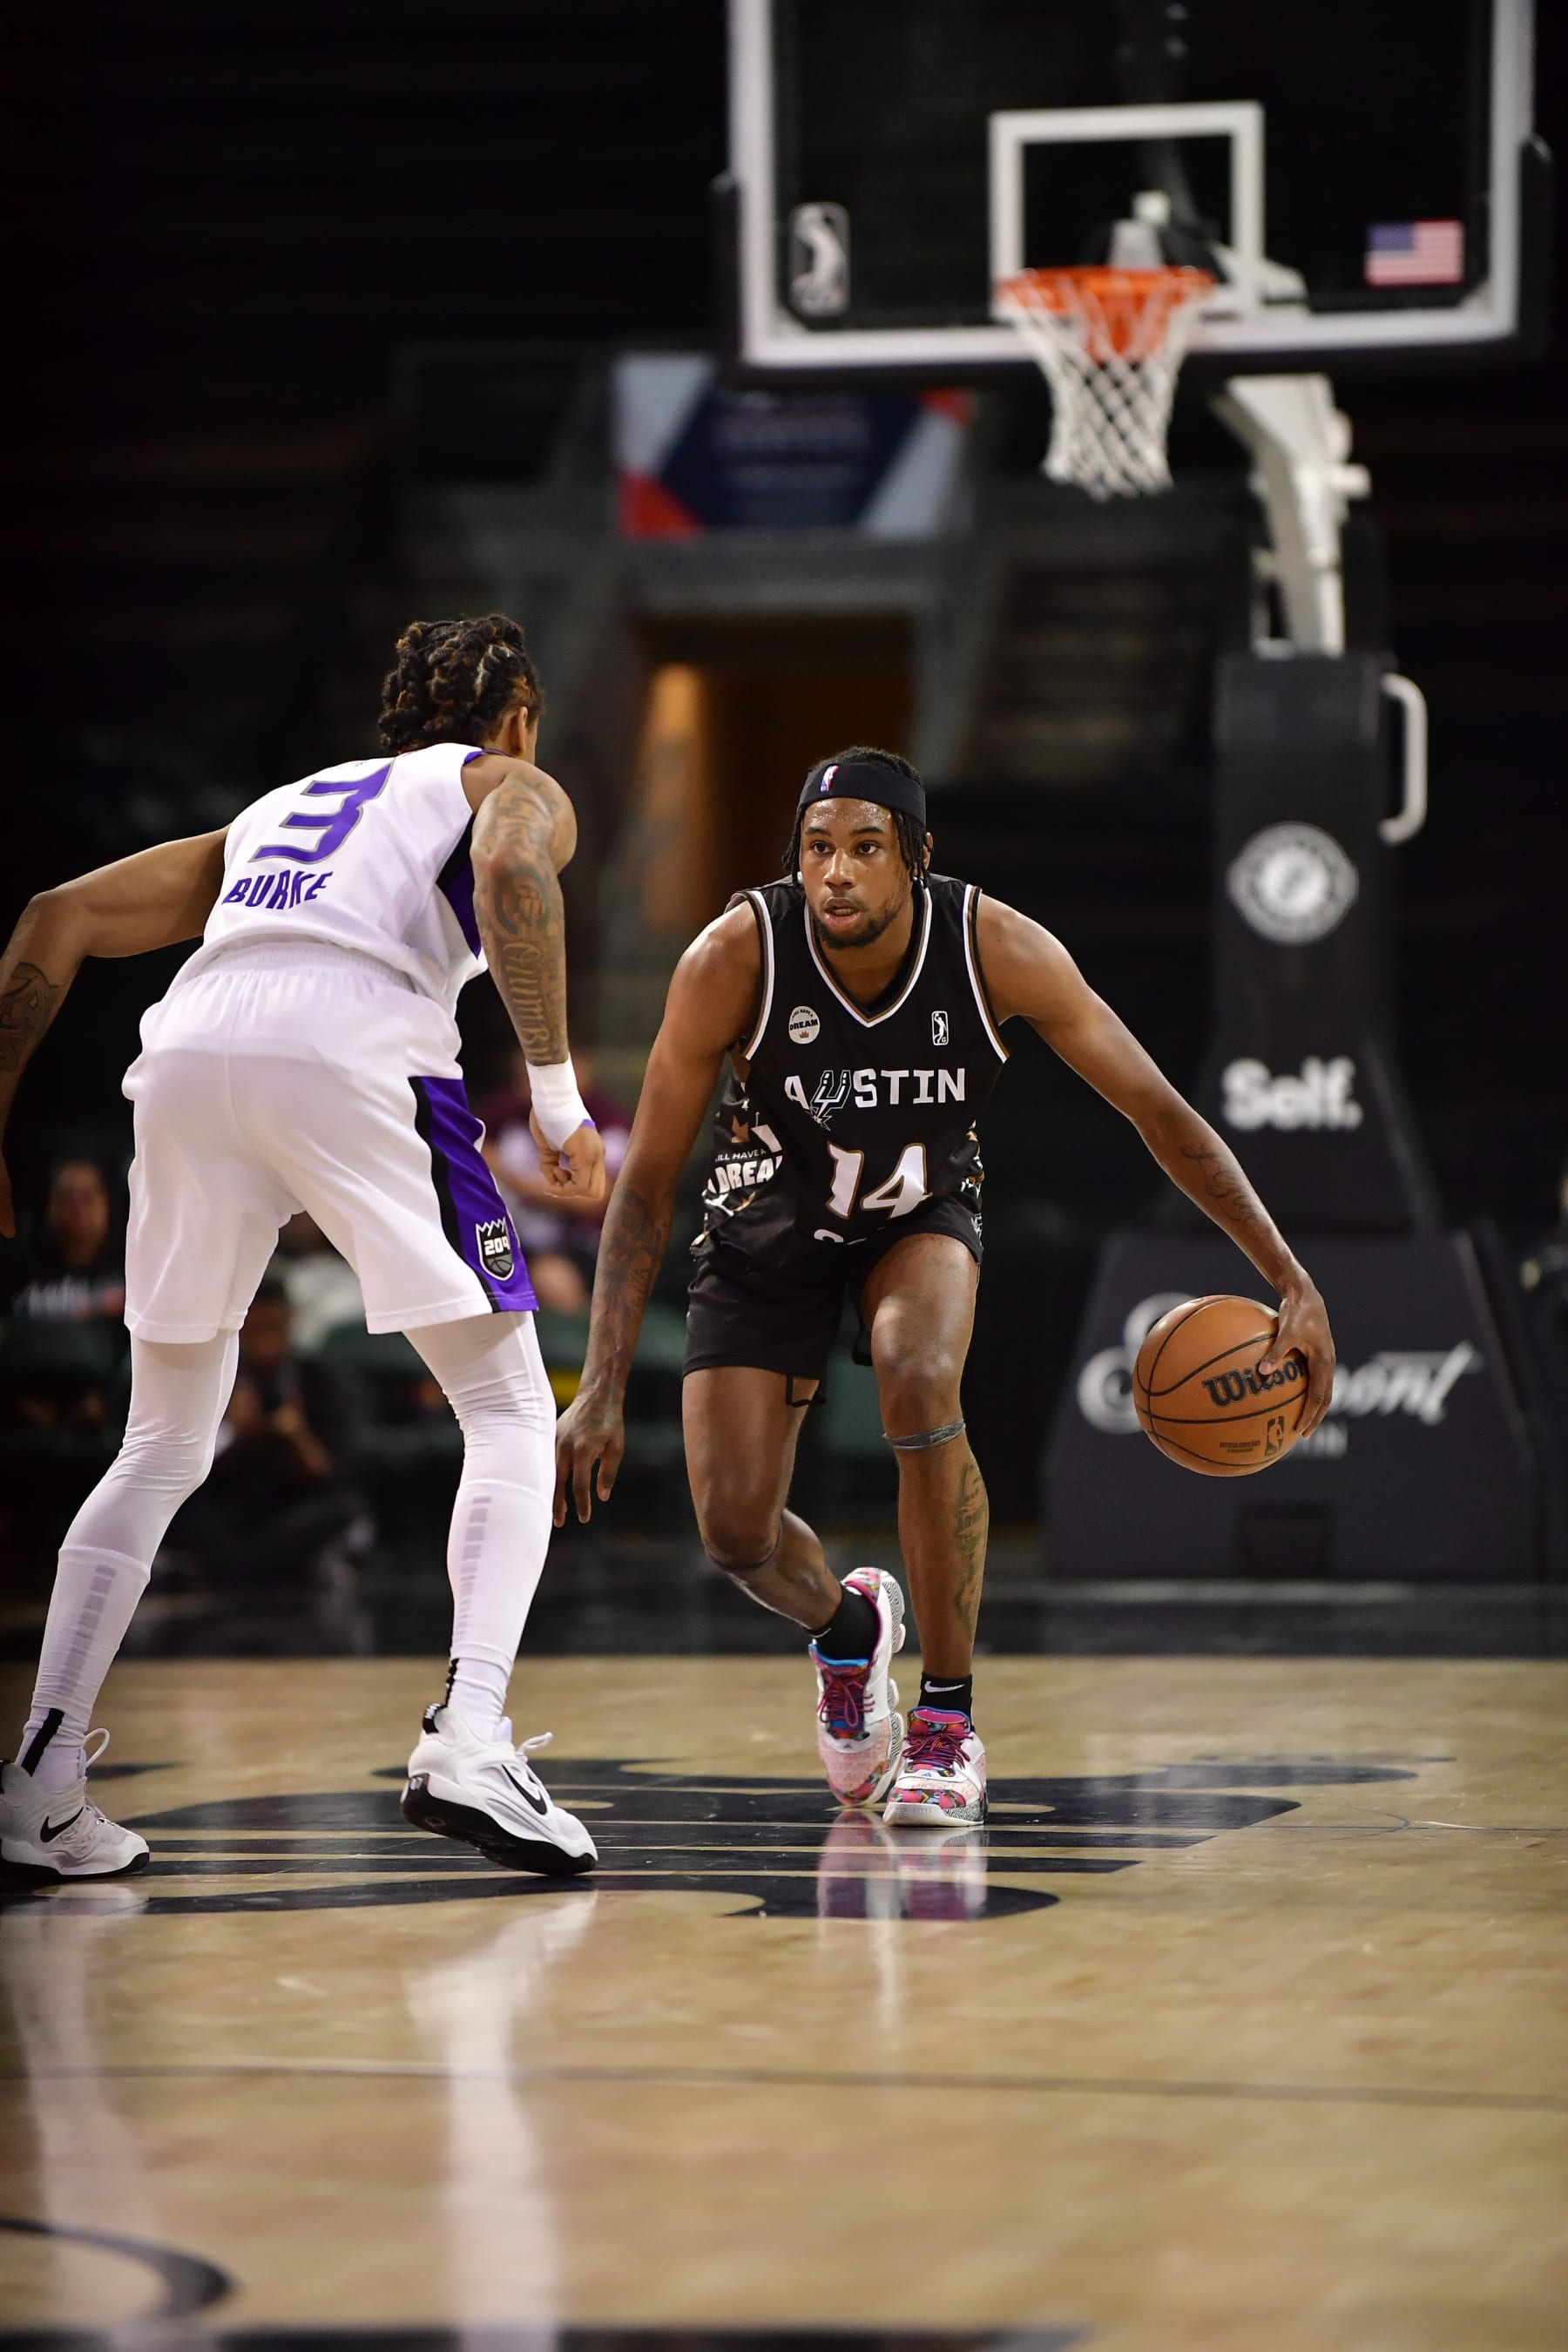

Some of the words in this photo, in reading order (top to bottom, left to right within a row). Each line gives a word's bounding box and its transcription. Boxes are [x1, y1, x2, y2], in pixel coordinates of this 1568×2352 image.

[247, 757, 396, 865] 3
[221, 869, 334, 910] BURKE
[790, 1018, 818, 1031] DREAM
[785, 1068, 966, 1131] AUSTIN
[733, 1149, 759, 1159] HAVE
[715, 1155, 782, 1194] DREA
[827, 1141, 933, 1220] 14
[483, 1236, 510, 1256] 209
